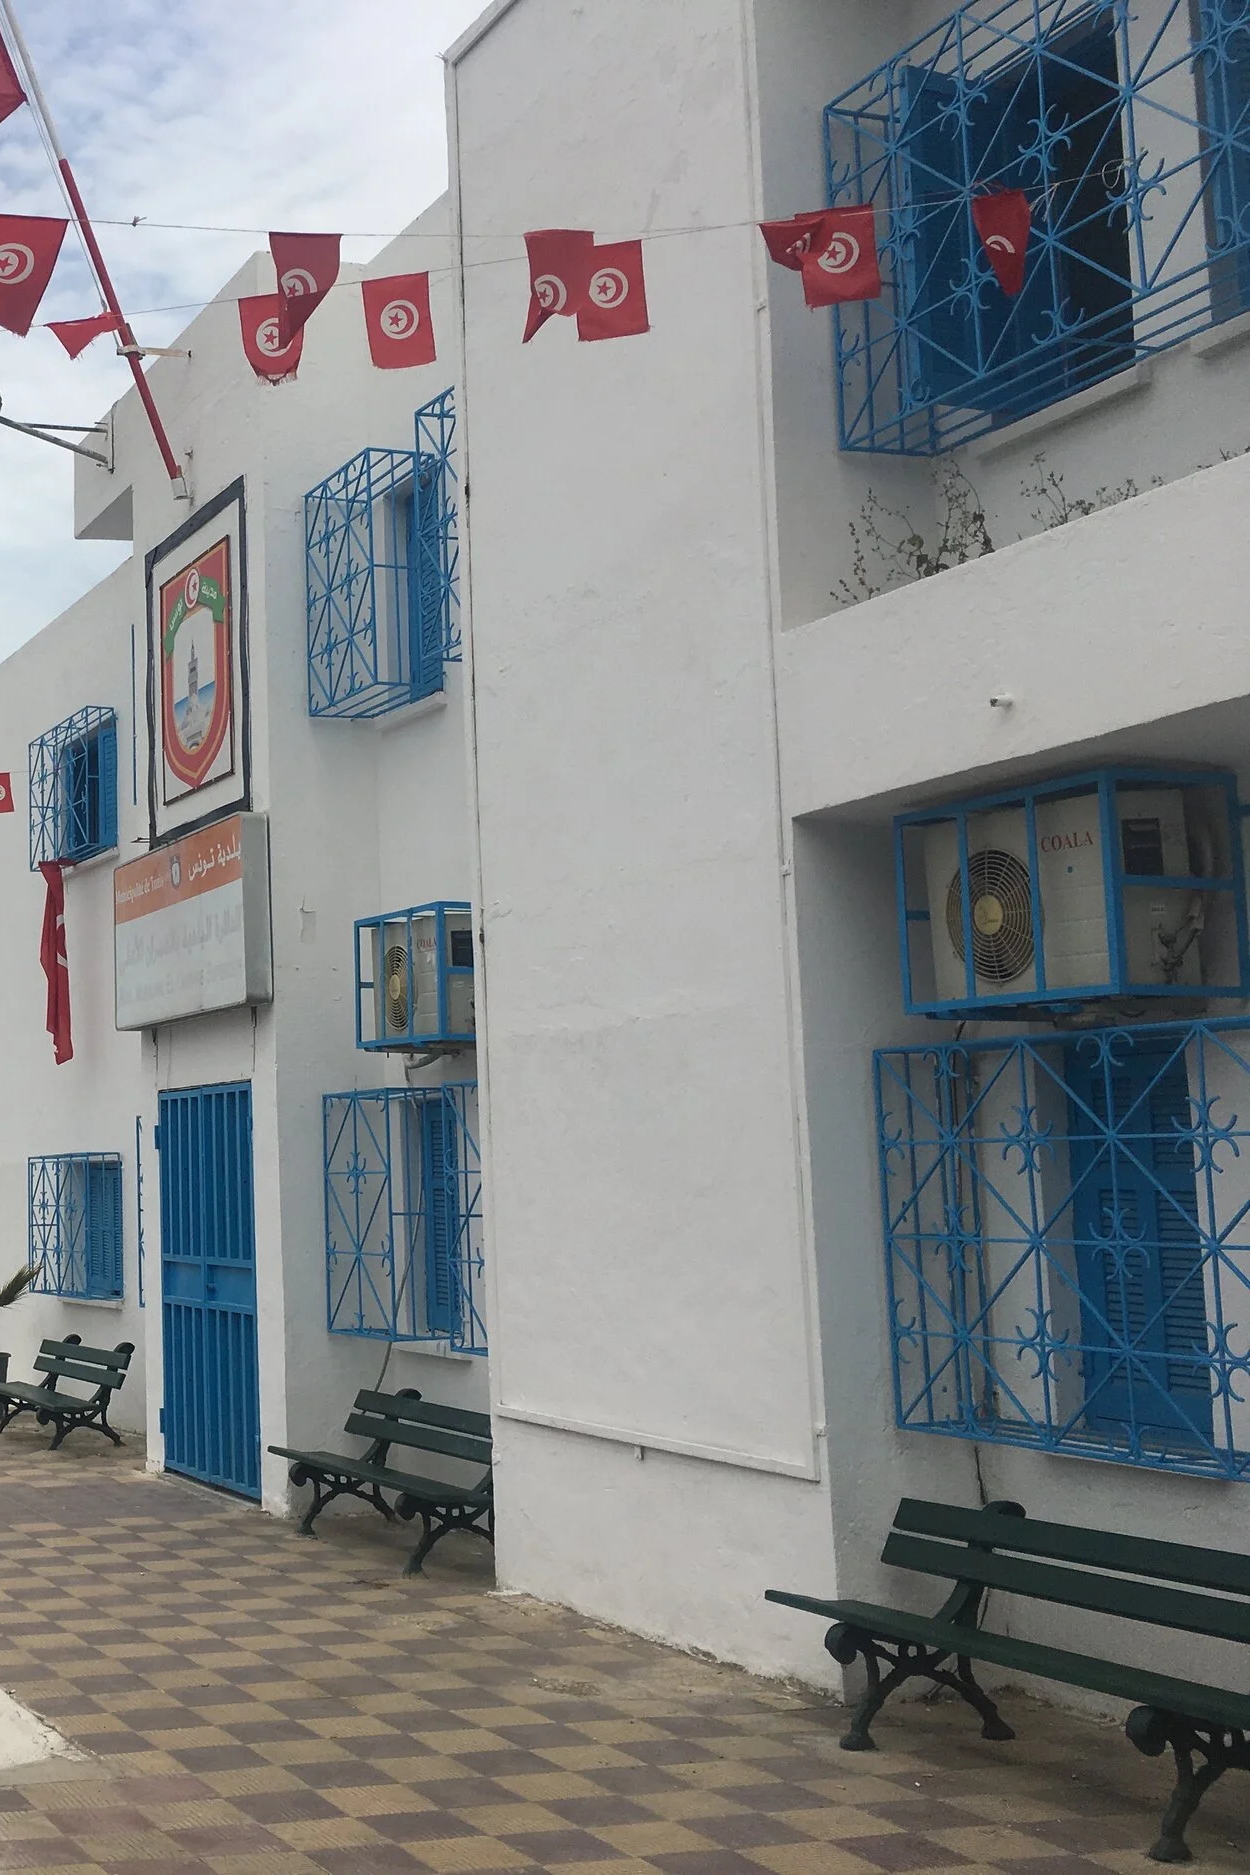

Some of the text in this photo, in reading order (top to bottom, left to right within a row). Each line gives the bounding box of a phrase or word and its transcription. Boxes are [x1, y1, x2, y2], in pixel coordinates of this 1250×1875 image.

[188, 833, 241, 881] بلدية تونس
[1040, 831, 1095, 853] COALA
